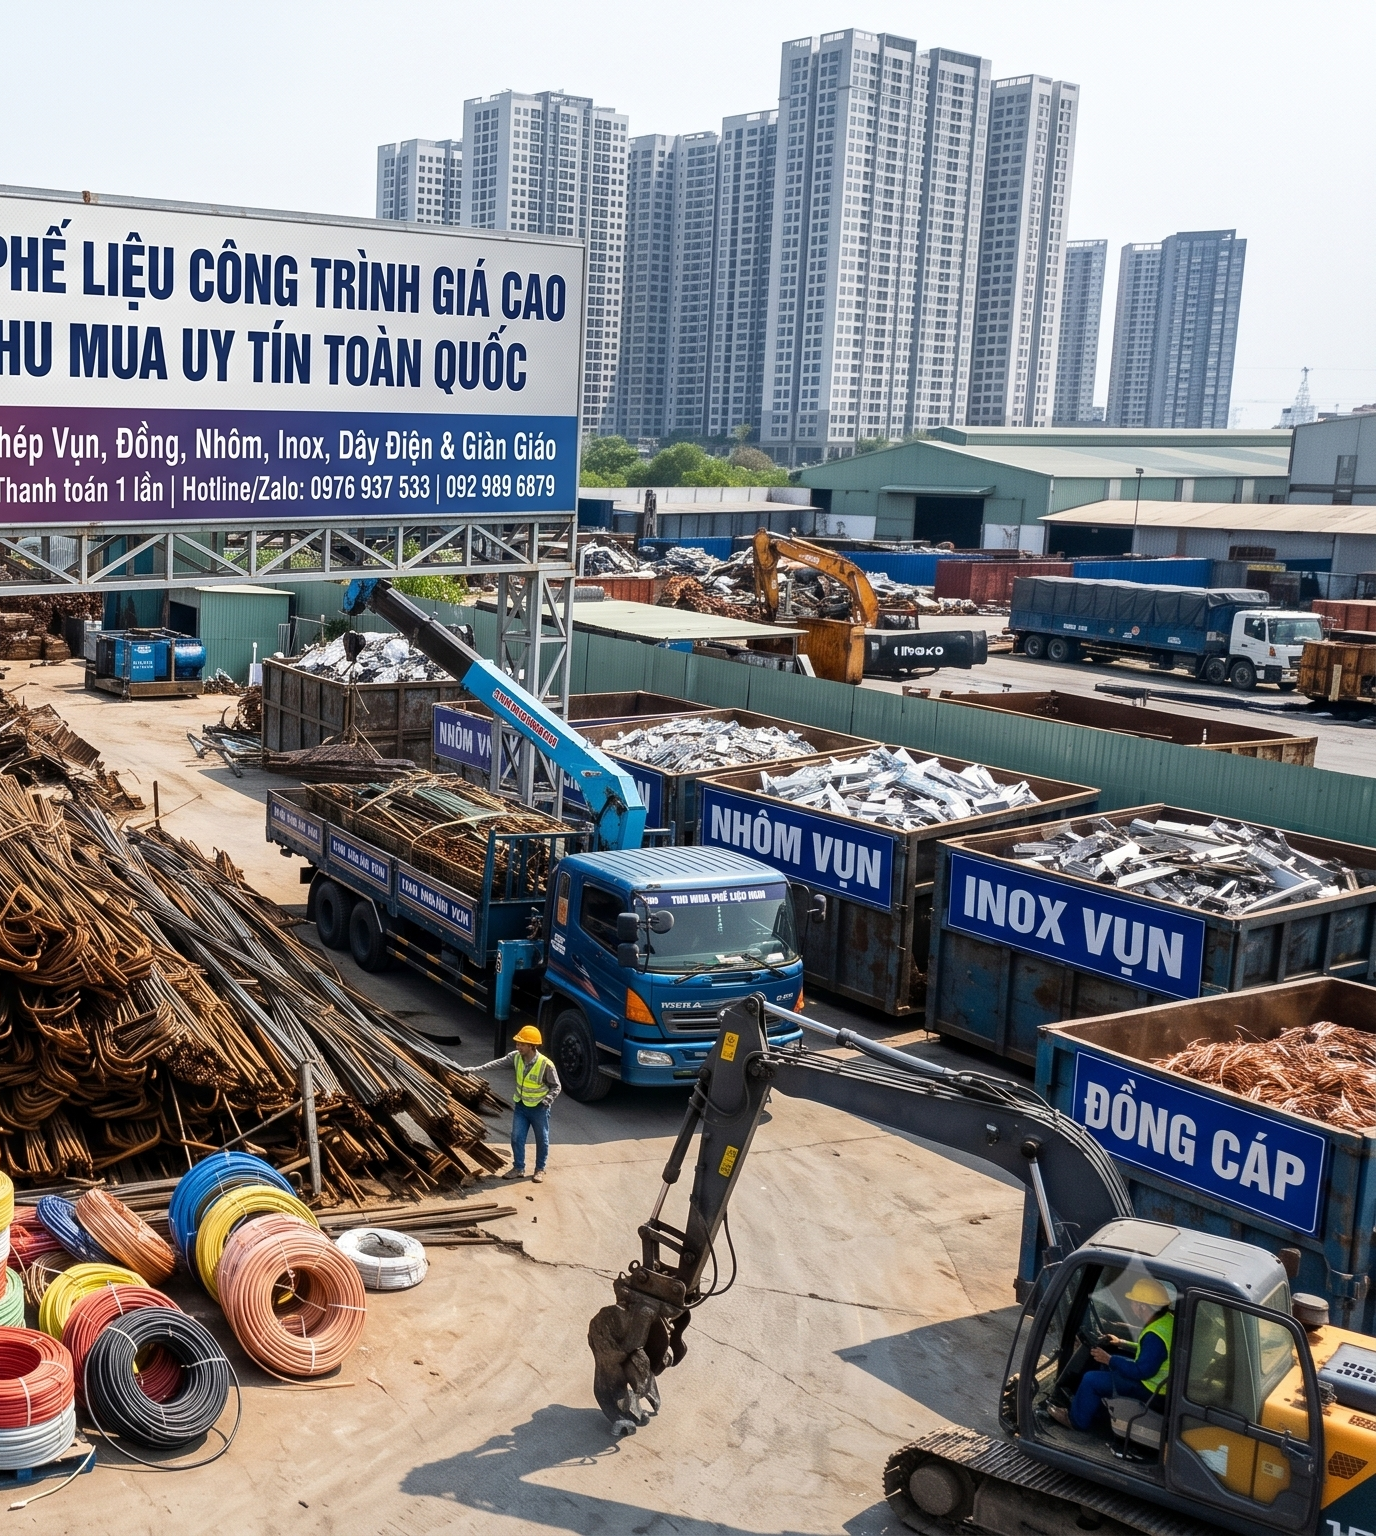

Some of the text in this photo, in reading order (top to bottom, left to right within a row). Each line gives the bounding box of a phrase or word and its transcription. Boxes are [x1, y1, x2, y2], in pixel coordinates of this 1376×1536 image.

[83, 231, 174, 311] LIỆU
[189, 238, 298, 307] CÔNG
[310, 248, 420, 314] TRÌNH
[432, 257, 490, 318] GIÁ
[501, 271, 566, 323] CAO
[69, 322, 168, 380] MUA
[182, 327, 236, 382] UY
[247, 319, 311, 385] TÍN
[323, 324, 422, 388] TOÀN
[434, 324, 527, 395] QUỐC
[51, 426, 107, 467] Vụn,
[115, 420, 186, 467] Đồng,
[196, 427, 269, 465] Nhôm,
[278, 429, 330, 465] Inox,
[339, 429, 380, 466] Dây
[385, 430, 433, 467] Điện
[440, 431, 455, 460] &
[462, 431, 507, 461] Giàn
[514, 431, 556, 461] Giáo
[63, 475, 108, 503] toán
[115, 476, 125, 502] 1
[134, 470, 163, 502] lần
[183, 475, 304, 504] Hotline/Zalo:
[310, 475, 355, 500] 0976
[360, 474, 394, 500] 937
[399, 474, 430, 499] 533
[446, 474, 477, 498] 092
[481, 474, 512, 498] 989
[516, 474, 555, 497] 6879
[710, 804, 882, 889] NHÔM VỤN
[963, 875, 1184, 977] INOX VỤN
[1084, 1078, 1306, 1201] ĐỒNG CÁP
